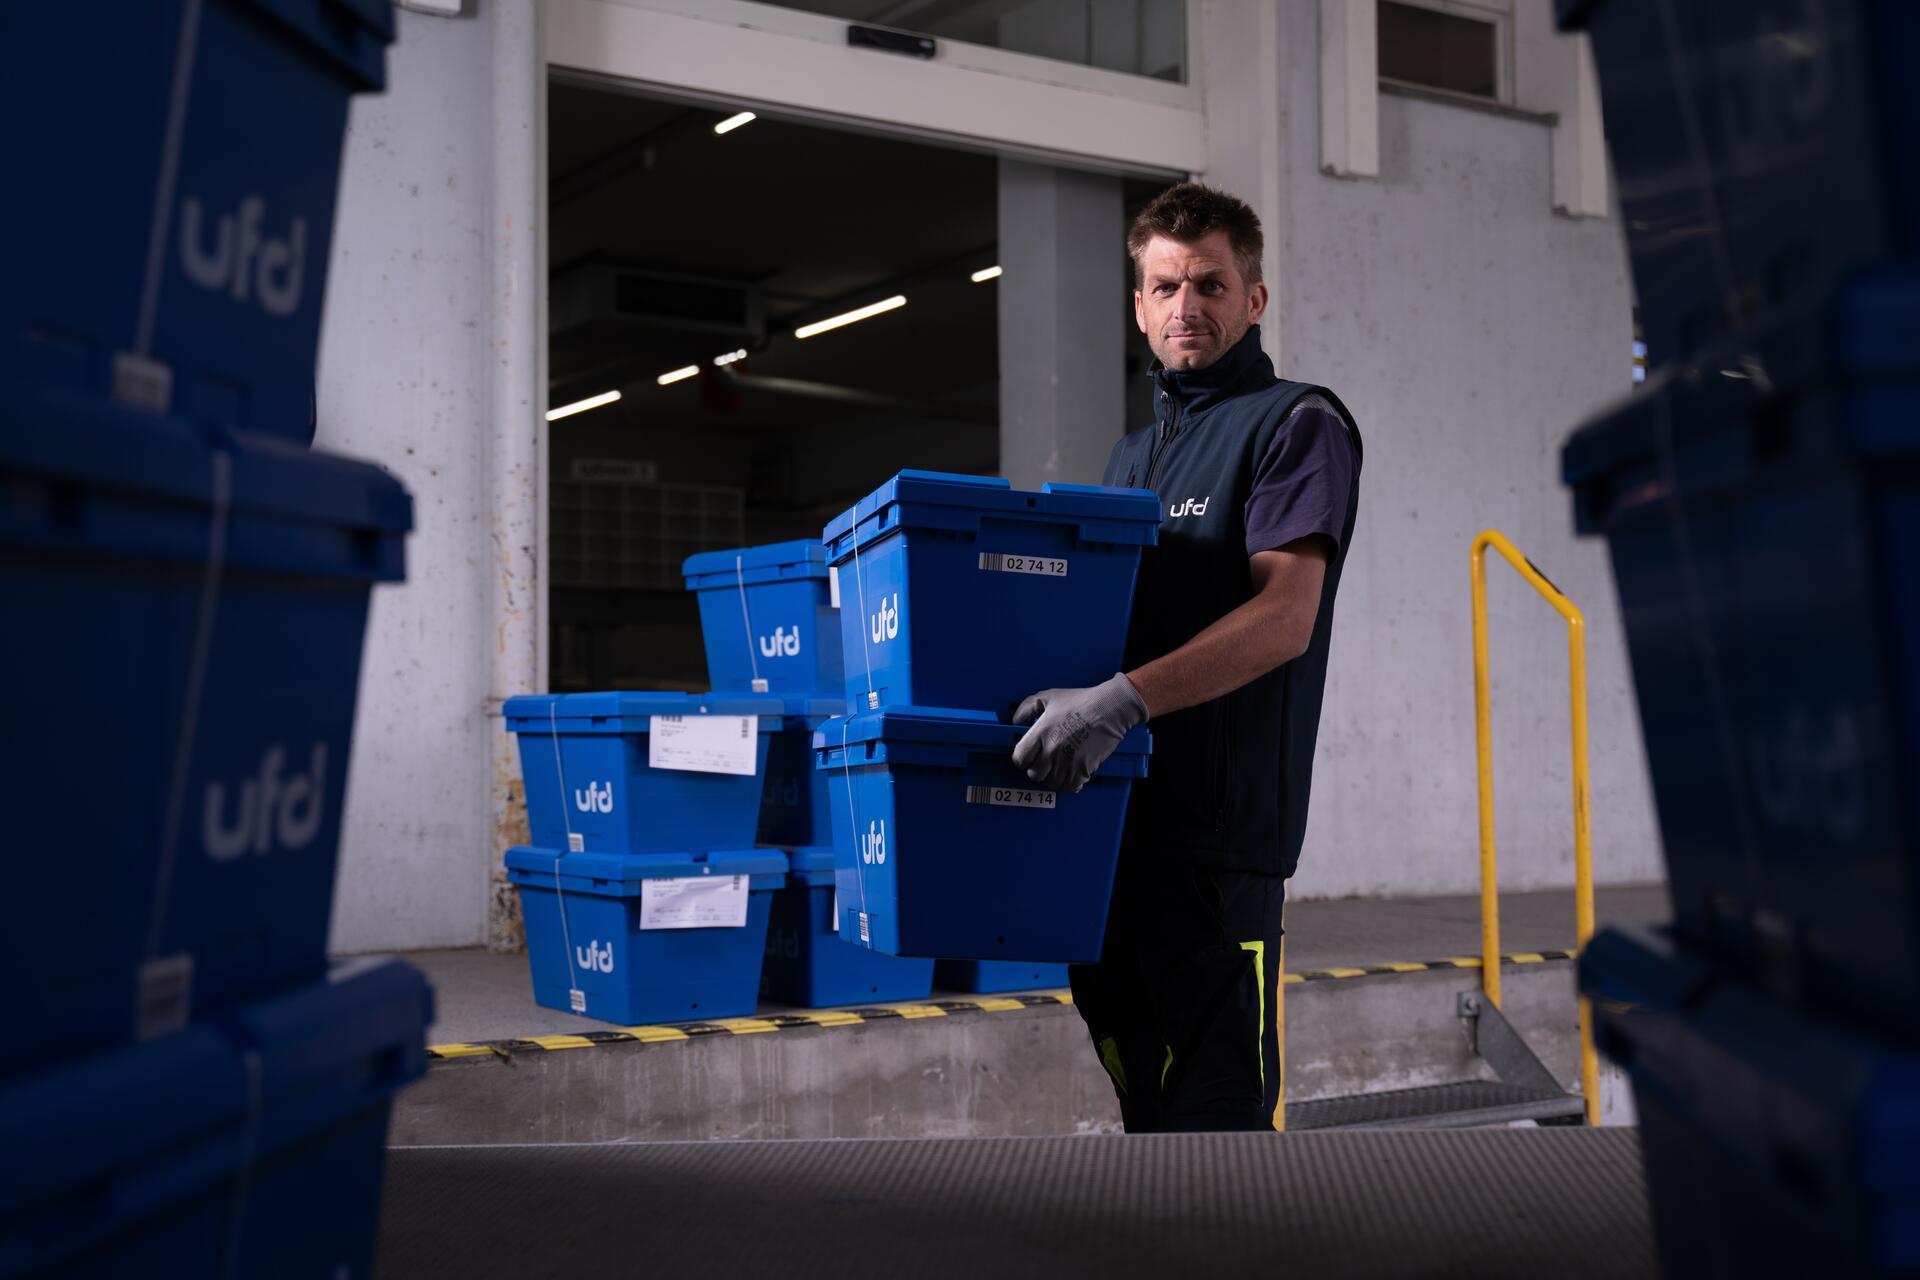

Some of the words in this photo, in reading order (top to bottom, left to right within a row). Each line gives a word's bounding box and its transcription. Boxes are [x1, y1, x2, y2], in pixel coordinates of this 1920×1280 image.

[178, 194, 308, 318] ufd
[1169, 496, 1210, 518] ufd
[1007, 558, 1024, 571] 02
[1028, 560, 1044, 572] 74
[1049, 561, 1065, 574] 12
[871, 593, 899, 644] ufd
[760, 624, 800, 658] ufd
[202, 740, 329, 862] ufd
[575, 780, 614, 813] ufd
[995, 790, 1012, 802] 02
[1016, 791, 1032, 804] 74
[1038, 793, 1054, 805] 14
[862, 819, 886, 865] ufd
[576, 939, 614, 974] ufd
